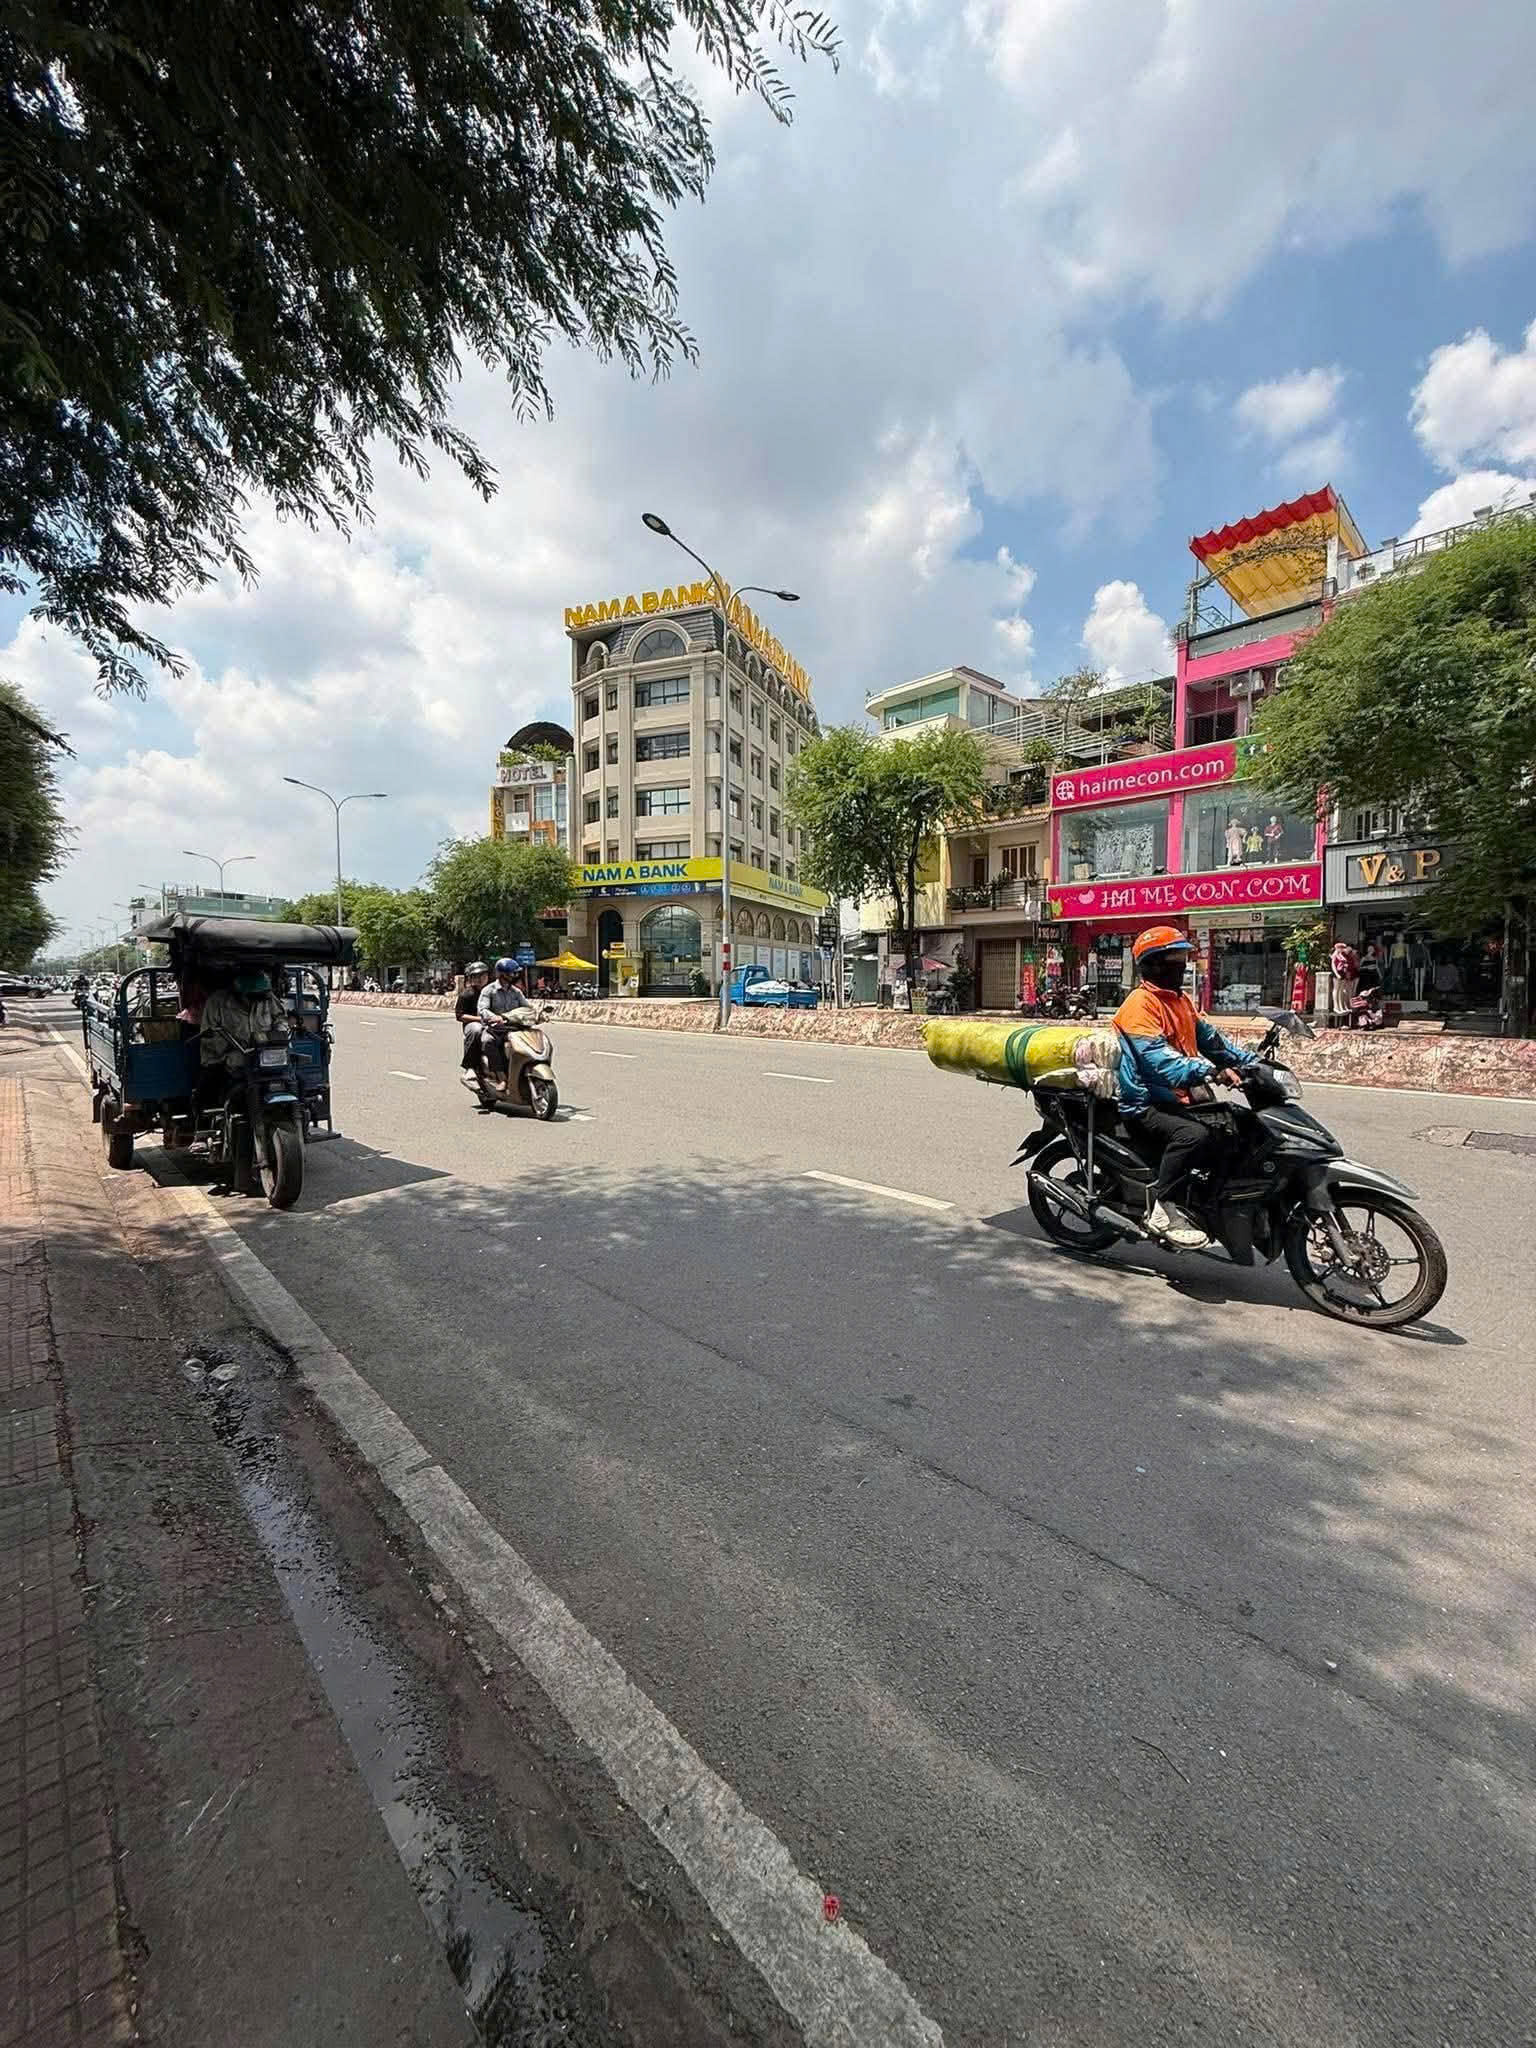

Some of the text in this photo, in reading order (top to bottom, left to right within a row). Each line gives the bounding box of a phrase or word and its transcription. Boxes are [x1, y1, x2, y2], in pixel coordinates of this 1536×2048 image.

[500, 766, 547, 783] HOTEL
[1080, 759, 1225, 797] haimecon.com
[583, 863, 689, 882] NAM A BANK
[1357, 853, 1387, 887] V
[1386, 863, 1407, 883] &
[1411, 849, 1441, 880] P
[1100, 887, 1137, 909] HAI
[1182, 873, 1312, 903] CON.COM
